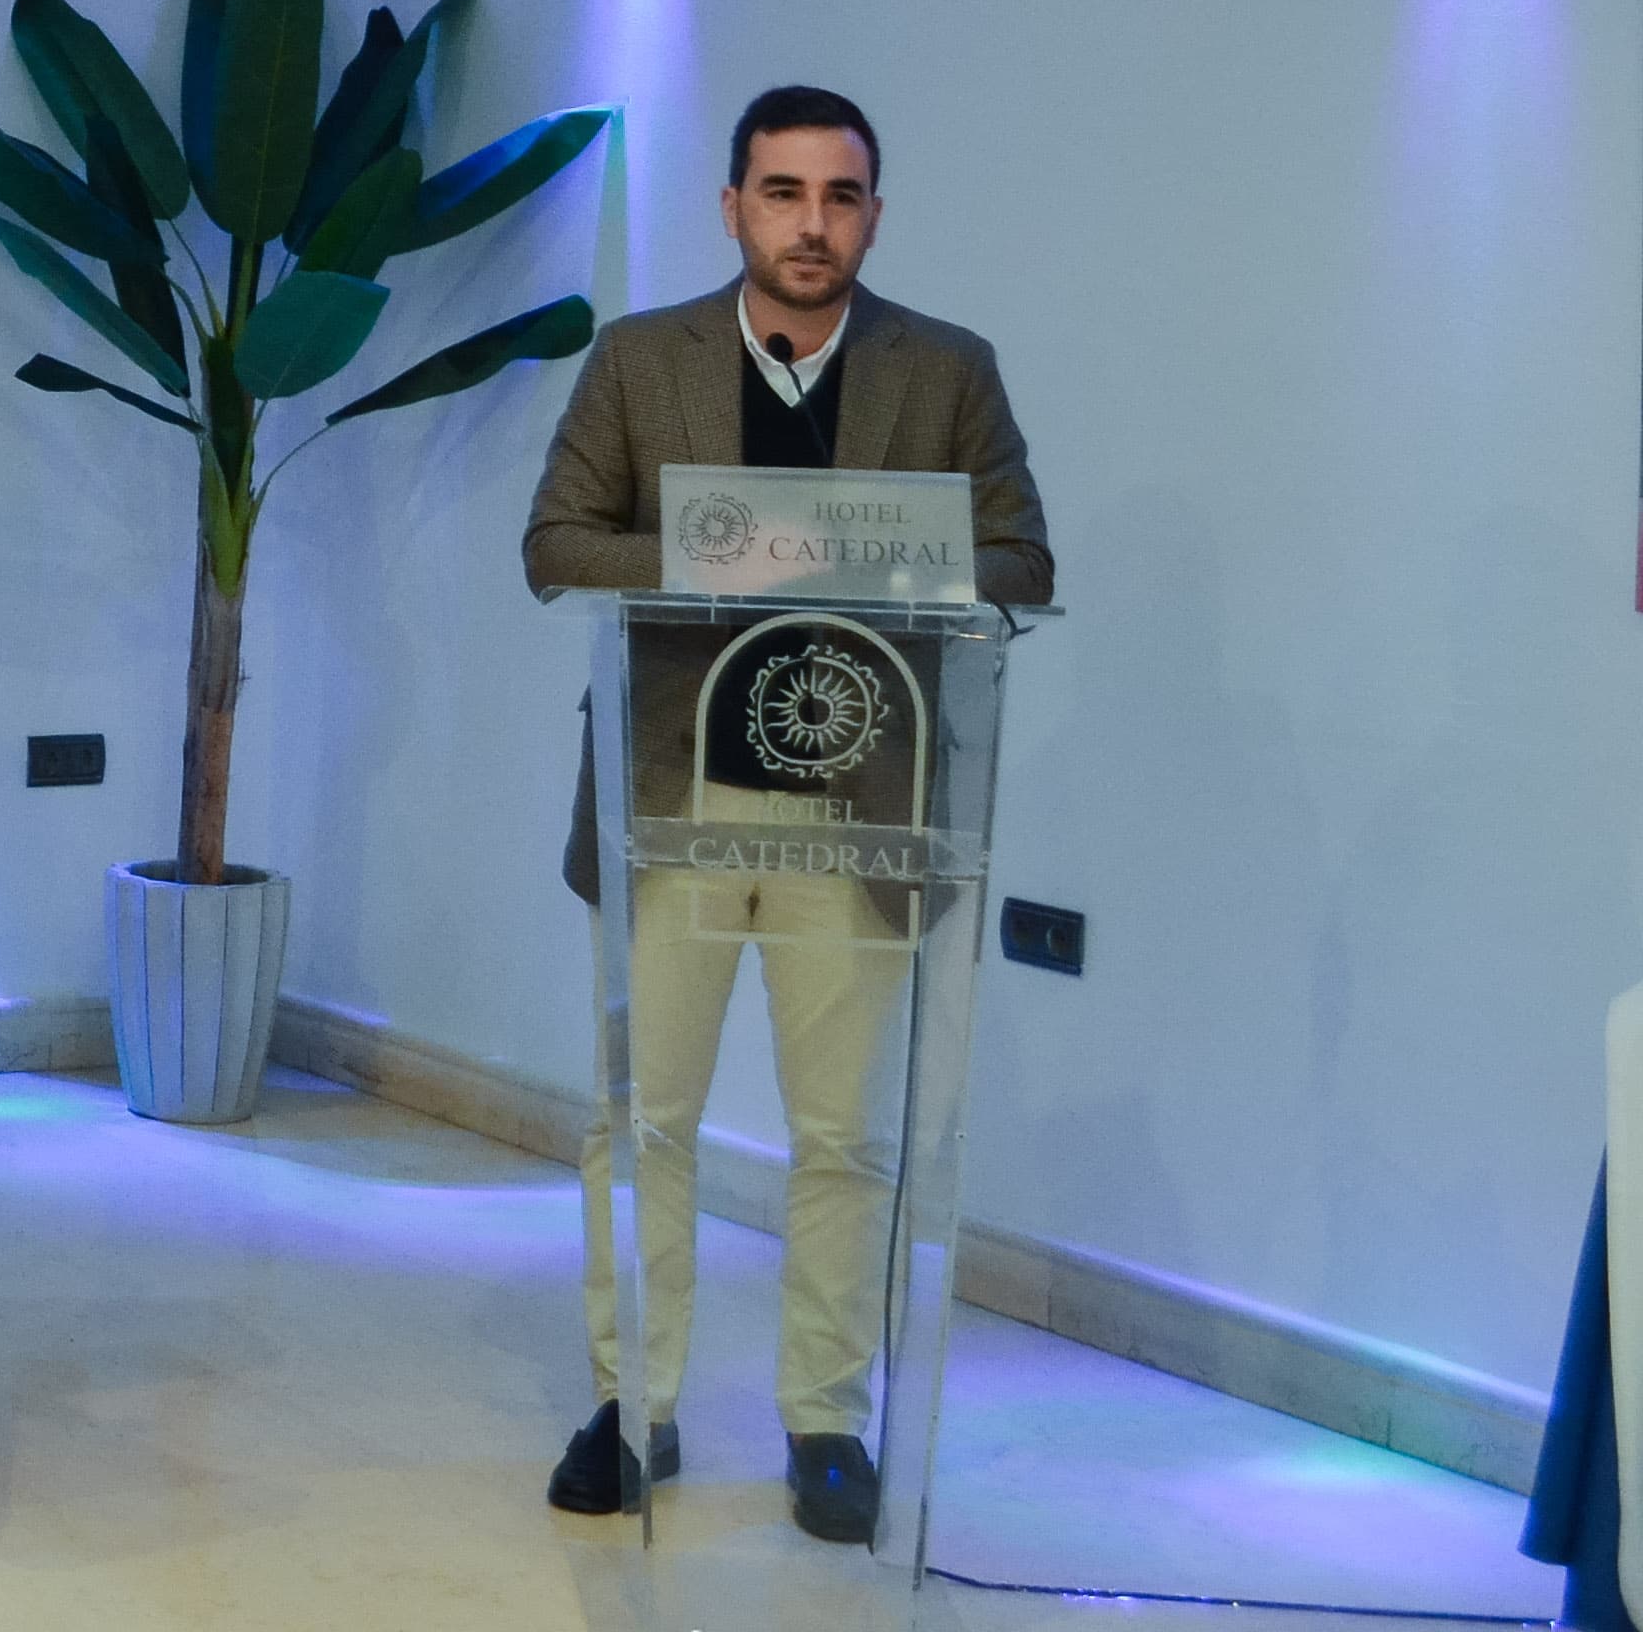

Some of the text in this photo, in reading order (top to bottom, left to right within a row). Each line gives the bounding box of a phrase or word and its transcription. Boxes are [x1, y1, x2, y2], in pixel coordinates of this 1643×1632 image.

[814, 500, 911, 524] HOTEL
[768, 536, 959, 568] CATEDRAL
[688, 837, 926, 879] CATEDRAL
